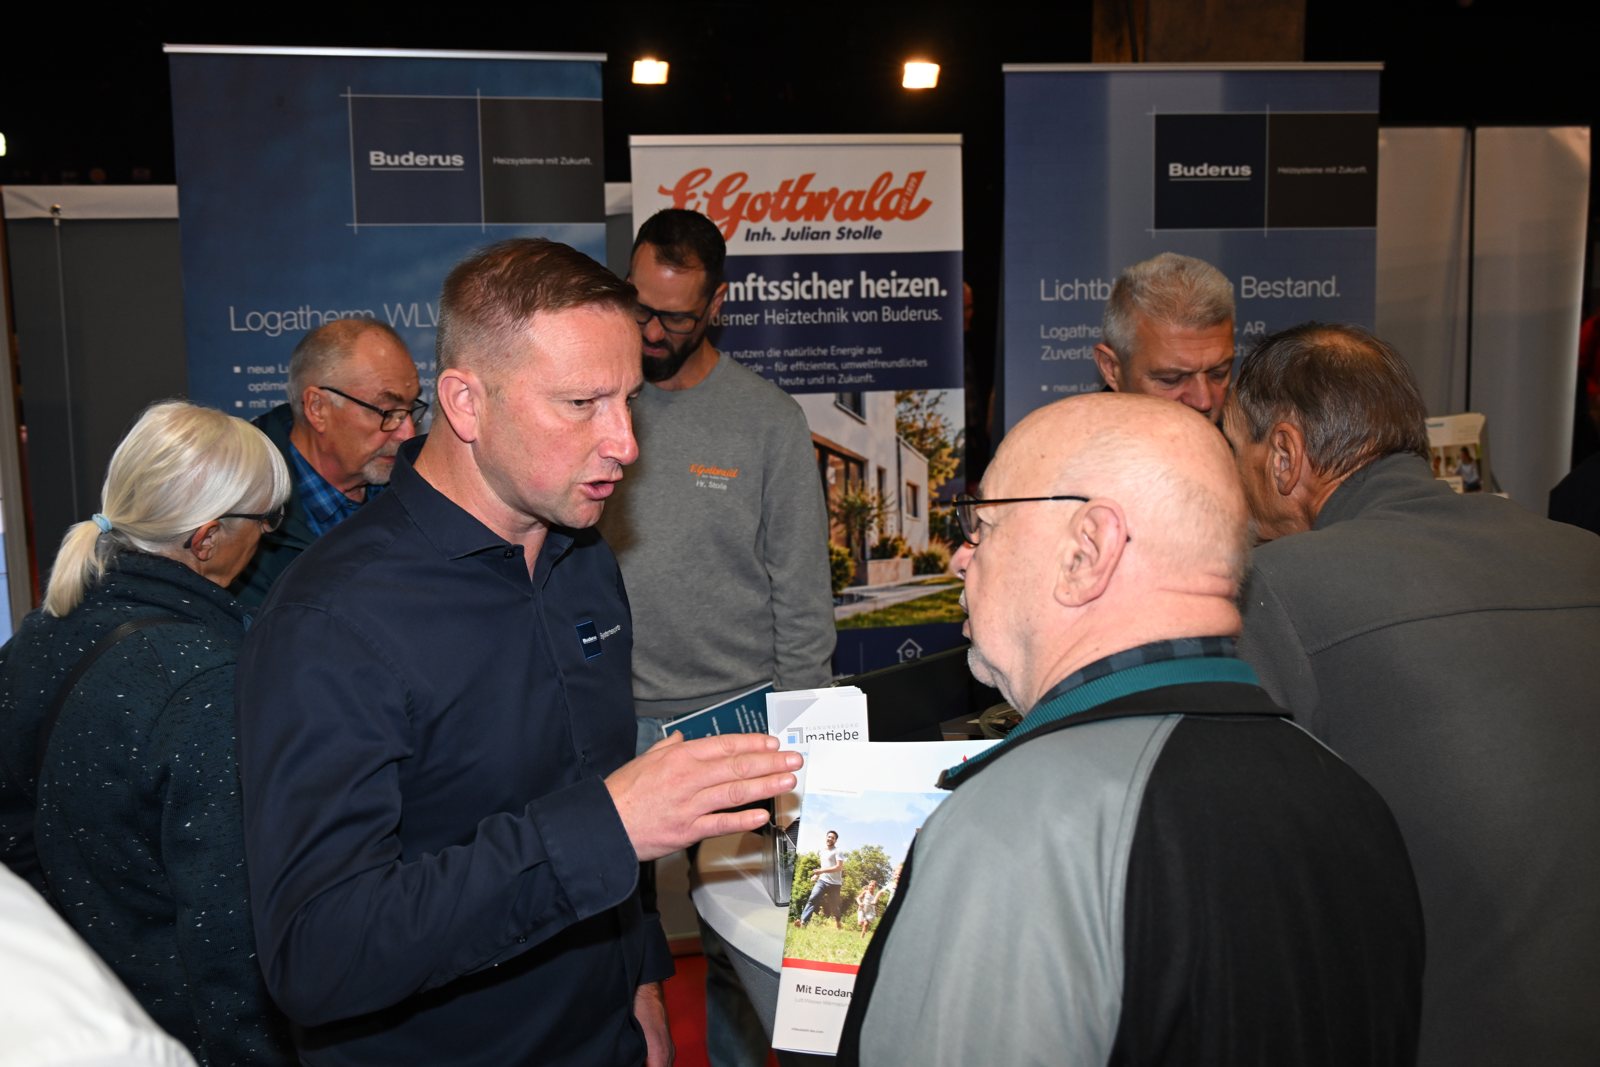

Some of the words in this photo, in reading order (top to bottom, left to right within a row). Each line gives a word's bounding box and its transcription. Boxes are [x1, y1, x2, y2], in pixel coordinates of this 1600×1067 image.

[369, 151, 465, 166] Buderus
[1169, 163, 1252, 176] Buderus
[745, 227, 776, 242] Inh.
[781, 226, 831, 241] Julian
[836, 225, 882, 240] Stolle
[723, 271, 854, 302] nftssicher
[860, 270, 948, 299] heizen.
[1041, 278, 1116, 301] Lichtb
[1241, 276, 1340, 299] Bestand.
[708, 311, 760, 327] derner
[764, 307, 849, 326] Heiztechnik
[852, 311, 878, 323] von
[881, 306, 943, 323] Buderus.
[1041, 324, 1102, 341] Logathe
[733, 349, 764, 358] nutzen
[767, 346, 781, 358] die
[830, 345, 865, 358] Energie
[1041, 346, 1094, 361] Zuverlä
[806, 729, 859, 743] matiebe
[796, 983, 812, 994] Mit
